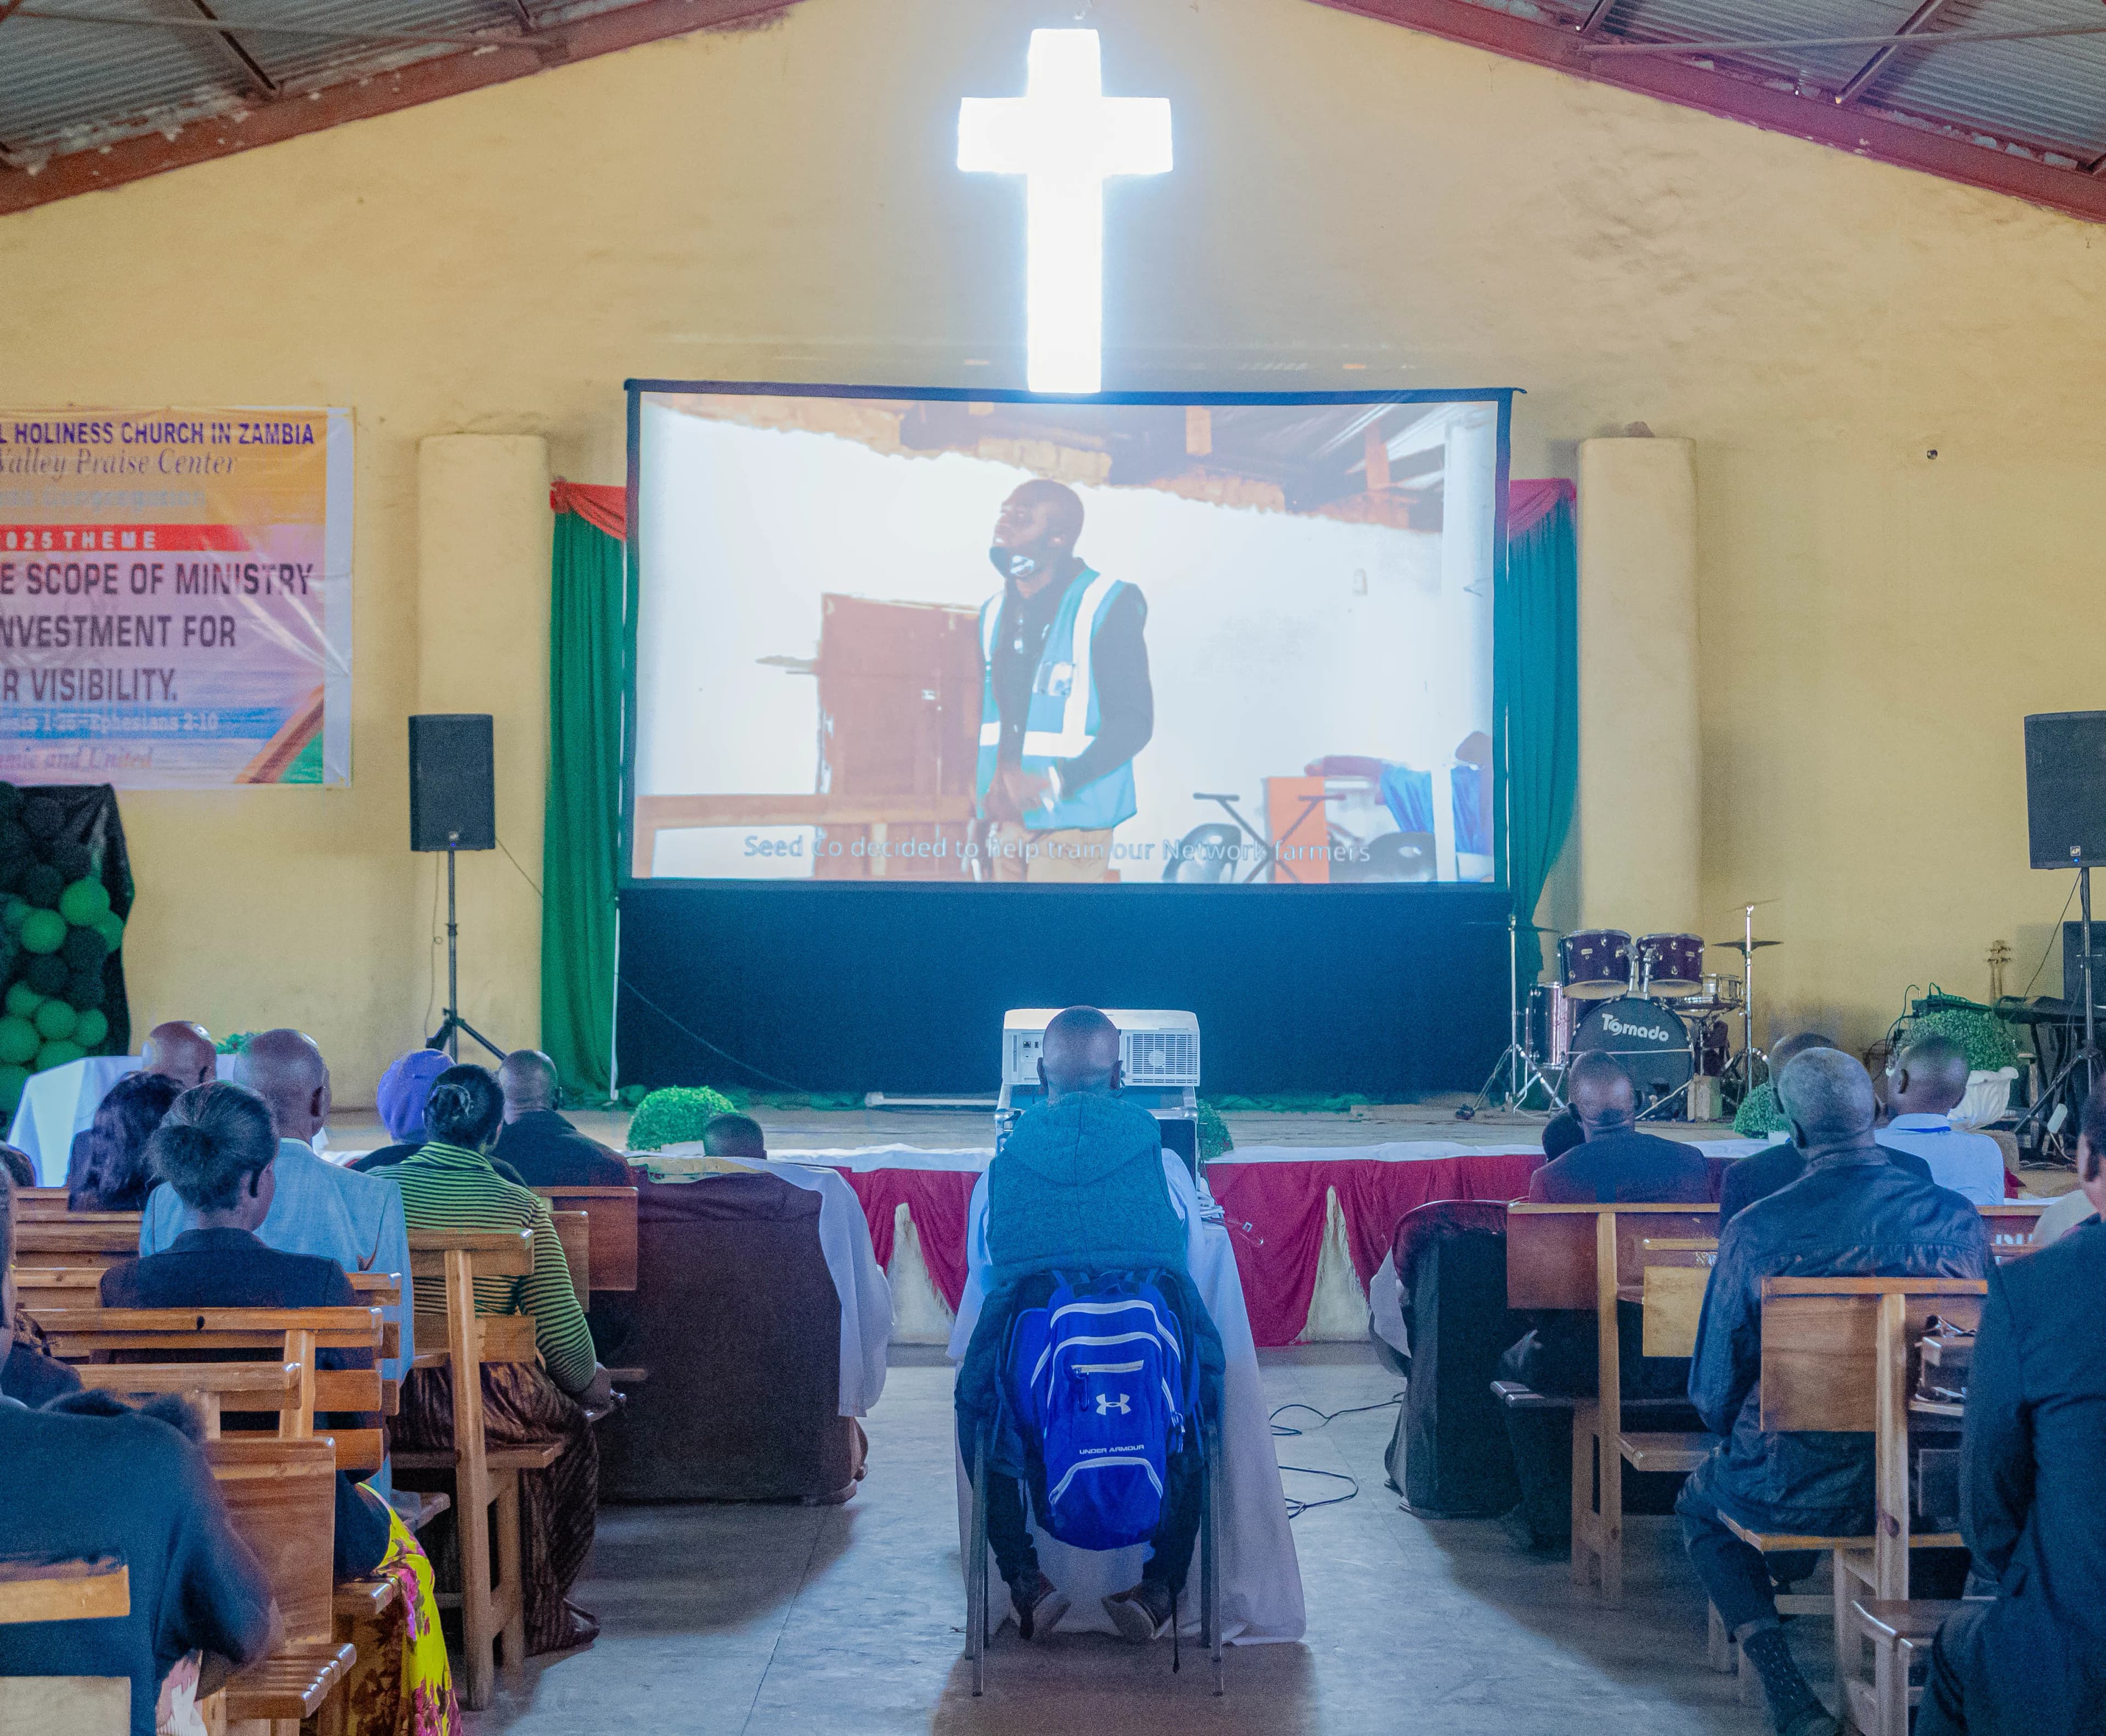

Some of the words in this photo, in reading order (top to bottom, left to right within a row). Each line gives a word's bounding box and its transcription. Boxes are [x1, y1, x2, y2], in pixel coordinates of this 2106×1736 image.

[14, 422, 113, 444] HOLINESS
[121, 422, 203, 445] CHURCH
[212, 423, 230, 444] IN
[239, 423, 315, 445] ZAMBIA
[76, 448, 150, 474] Praise
[158, 448, 237, 474] Center
[63, 530, 156, 549] THEME
[27, 563, 118, 595] SCOPE
[130, 563, 163, 595] OF
[176, 563, 314, 595] MINISTRY
[183, 615, 236, 648] FOR
[744, 835, 803, 858] Seed
[813, 835, 842, 858] Co
[851, 835, 947, 858] decided
[955, 839, 979, 859] to
[988, 836, 1038, 864] help
[1048, 839, 1103, 860] train
[1111, 843, 1155, 860] our
[1162, 838, 1267, 861] Network
[1275, 839, 1371, 863] farmers
[1601, 1013, 1669, 1042] Tornado
[1109, 1444, 1144, 1453] ARMOUR
